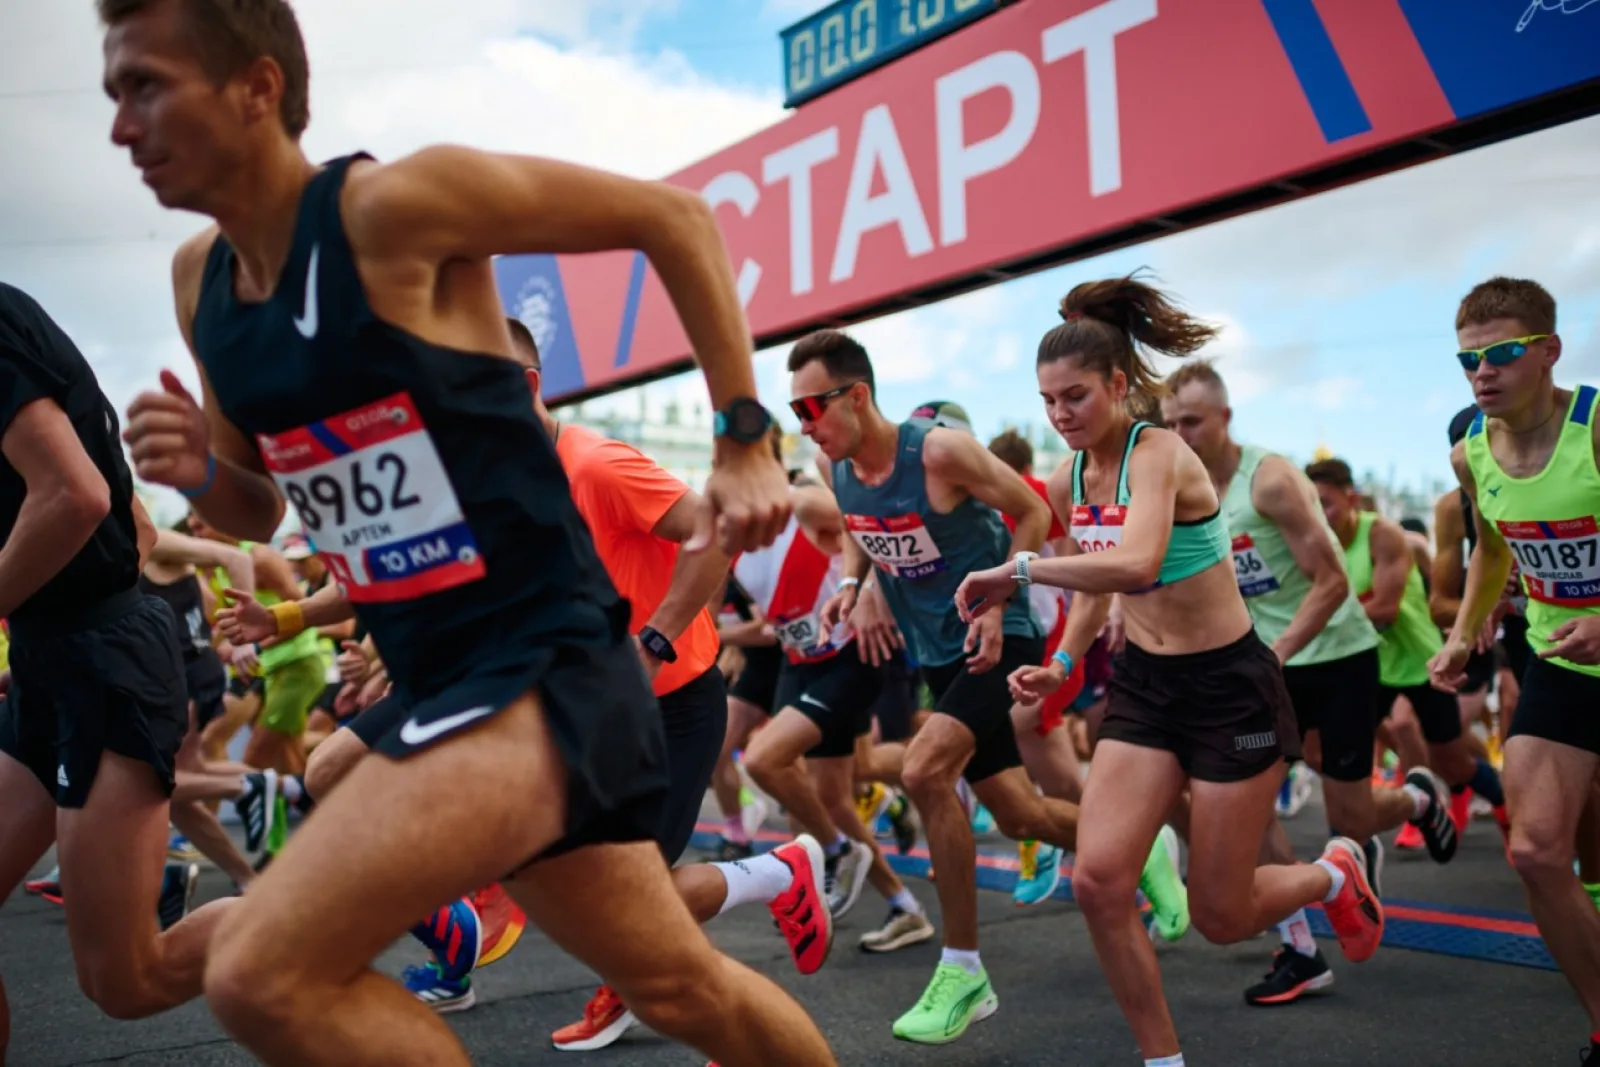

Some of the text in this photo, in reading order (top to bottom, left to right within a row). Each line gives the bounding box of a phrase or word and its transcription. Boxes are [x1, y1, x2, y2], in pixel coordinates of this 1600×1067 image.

[700, 0, 1158, 312] СТАРТ
[285, 452, 421, 532] 8962
[342, 523, 394, 548] АРТЕМ
[862, 534, 924, 557] 8872
[379, 552, 407, 573] 10
[1233, 552, 1262, 576] 36
[1510, 538, 1598, 570] 10187
[1564, 585, 1580, 596] 10
